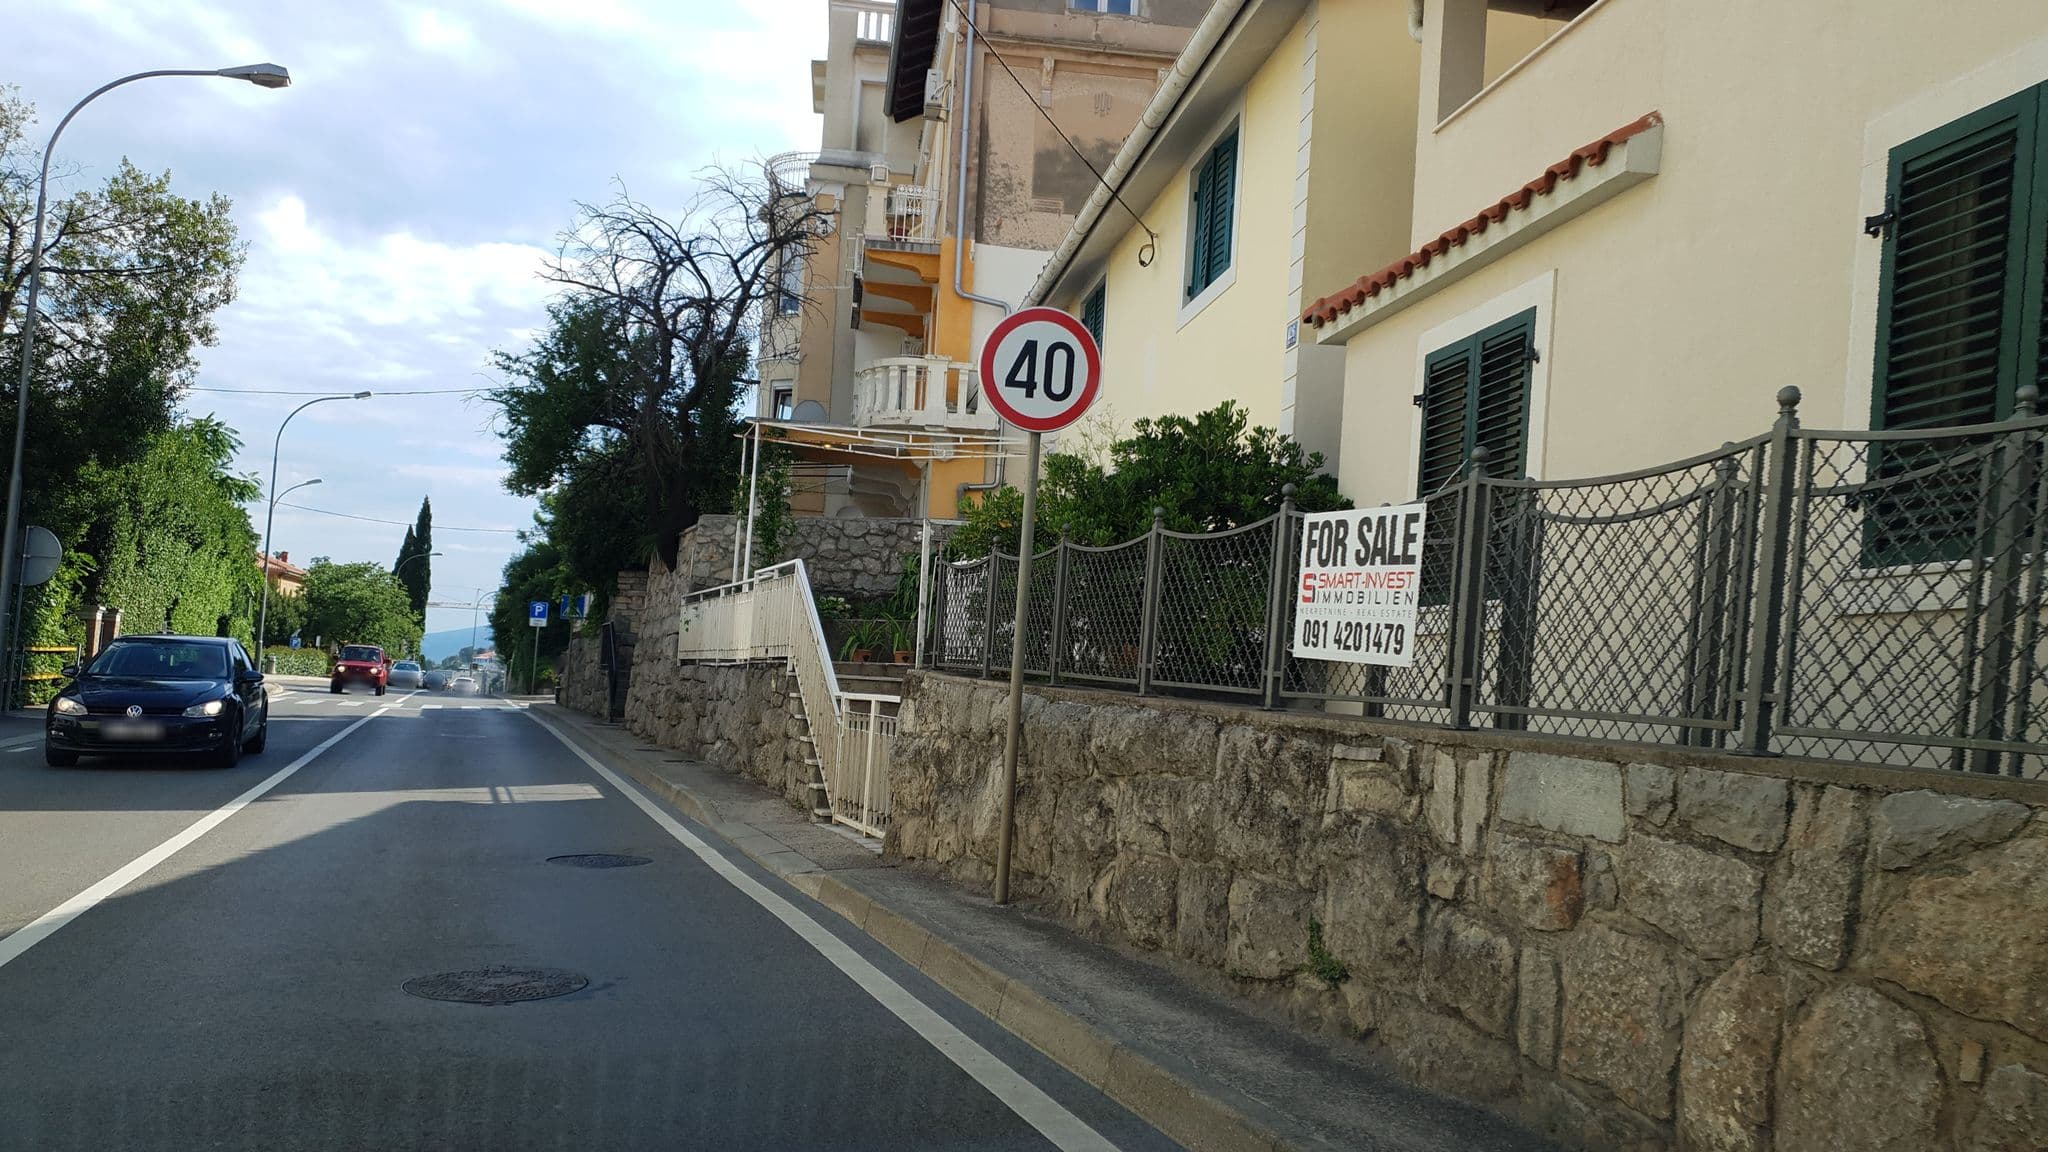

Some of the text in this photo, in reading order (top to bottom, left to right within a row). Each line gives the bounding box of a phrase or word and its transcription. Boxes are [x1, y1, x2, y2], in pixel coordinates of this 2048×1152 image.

[1005, 339, 1075, 402] 40
[1305, 513, 1420, 568] FOR SALE
[1318, 572, 1415, 589] SMART-INVEST
[1316, 591, 1414, 605] IMMOBILIEN
[535, 605, 544, 616] P
[1357, 608, 1376, 616] REAL
[1381, 609, 1412, 618] ESTATE
[1302, 619, 1405, 655] 091 4201479
